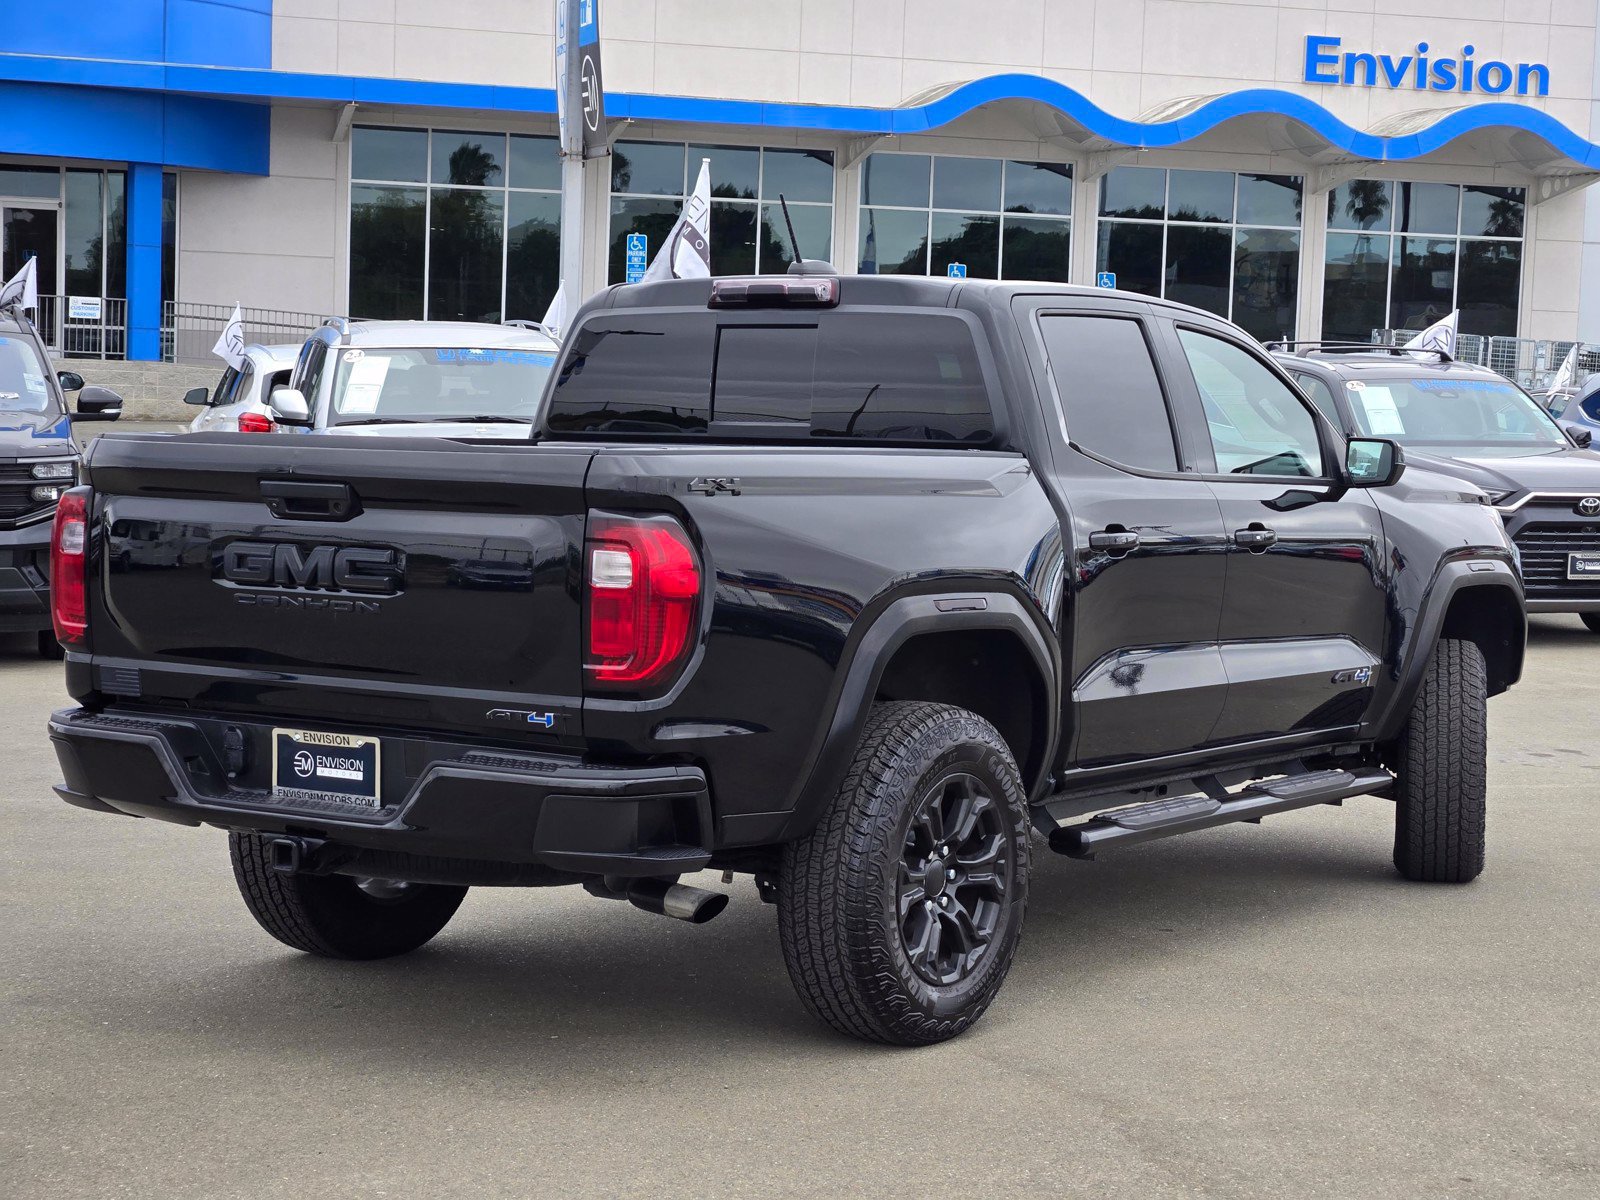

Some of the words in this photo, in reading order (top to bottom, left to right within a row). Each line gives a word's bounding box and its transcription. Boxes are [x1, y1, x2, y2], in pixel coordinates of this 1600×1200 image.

[1304, 35, 1550, 96] Envision
[224, 541, 394, 592] GMC
[233, 592, 381, 614] CANYON
[303, 732, 351, 746] ENVISION
[316, 756, 364, 772] ENVISION
[988, 755, 1027, 885] GOODYEAR
